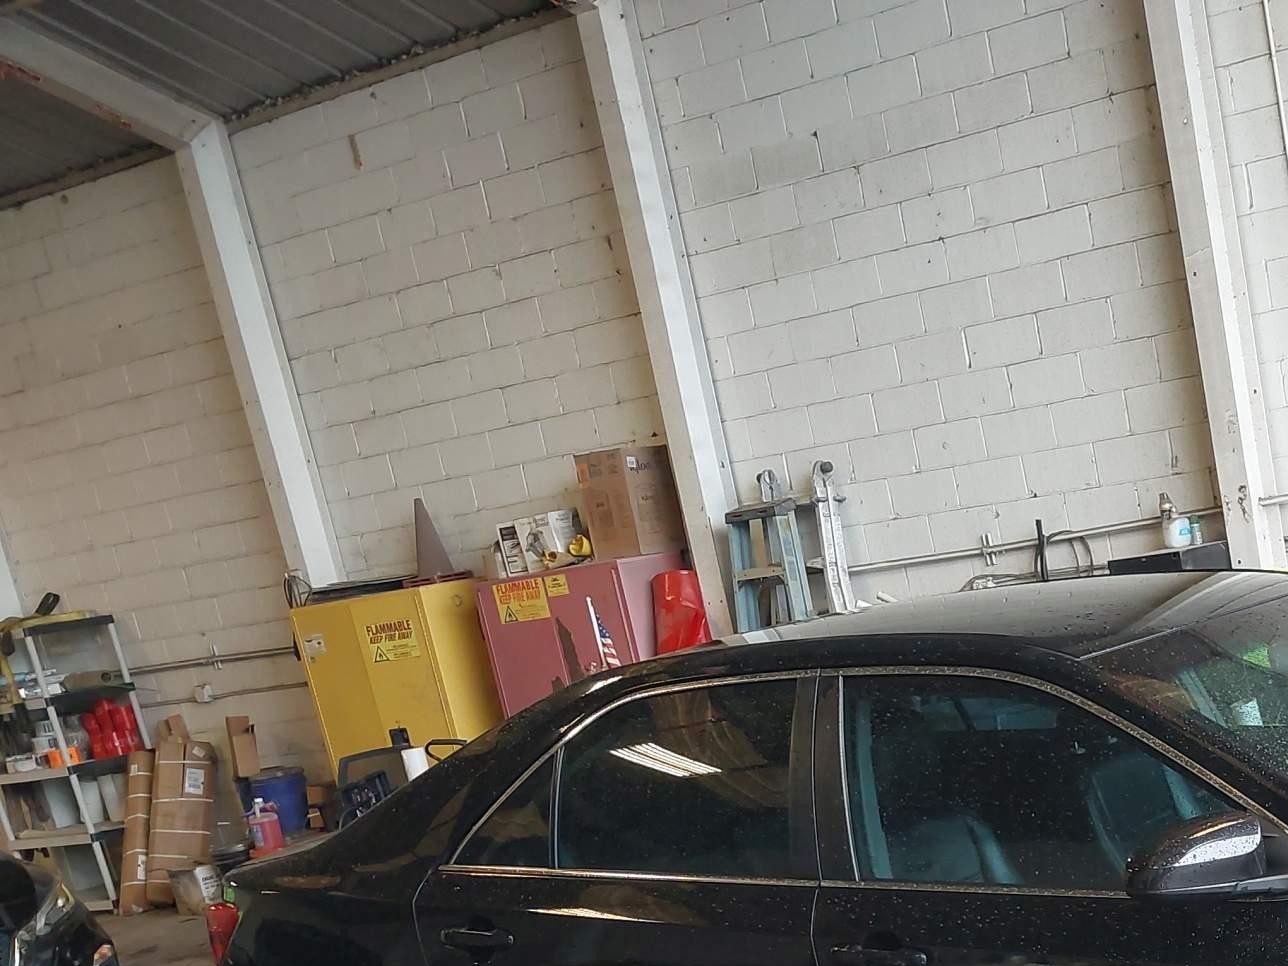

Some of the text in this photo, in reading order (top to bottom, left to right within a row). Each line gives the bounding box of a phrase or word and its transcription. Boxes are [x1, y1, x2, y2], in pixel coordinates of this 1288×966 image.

[496, 578, 540, 594] FLAMMABLE
[366, 619, 412, 636] FLAMMABLE
[370, 631, 413, 645] KEEP FIRE AWAY
